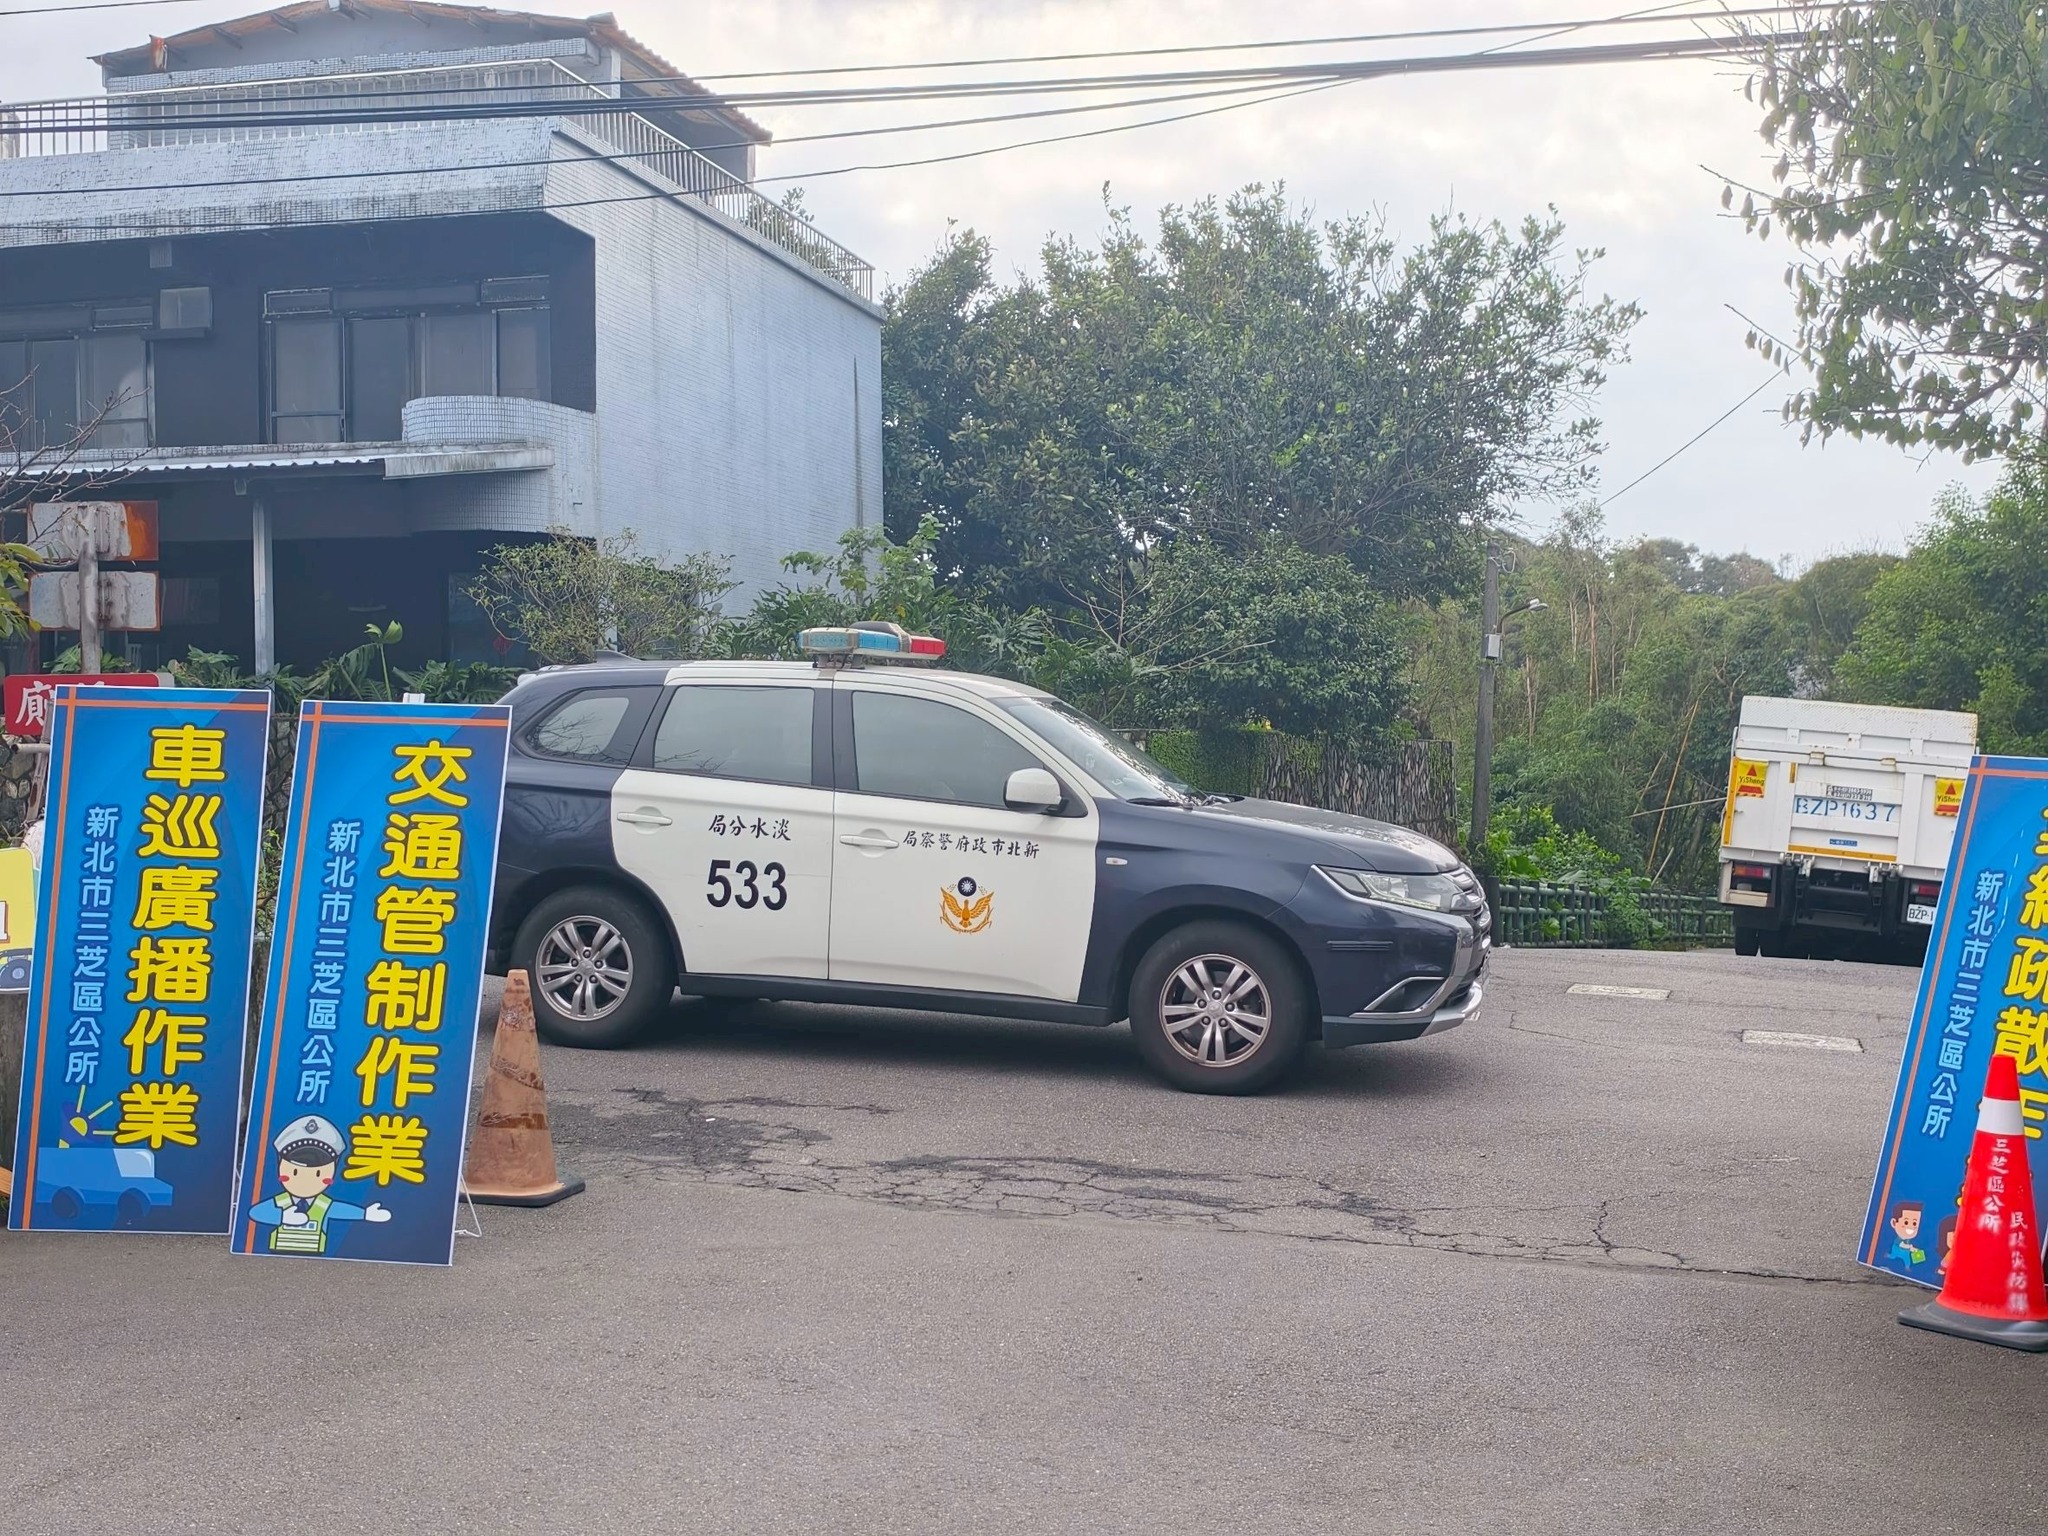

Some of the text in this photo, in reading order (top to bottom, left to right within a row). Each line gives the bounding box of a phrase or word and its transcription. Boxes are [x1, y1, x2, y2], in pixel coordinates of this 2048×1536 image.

[706, 859, 788, 911] 533
[708, 814, 792, 841] 淡水分局
[902, 830, 1040, 859] 新北市政府警察局
[1795, 797, 1896, 822] BZP1637
[65, 805, 120, 1085] 新北市三芝區公所
[115, 725, 225, 1149] 車巡廣播作業
[296, 820, 361, 1105] 新北市三芝區公所
[344, 741, 472, 1186] 交通管制作業
[1908, 908, 1934, 922] BZP-1
[1922, 871, 2005, 1139] 新北市三芝區公所
